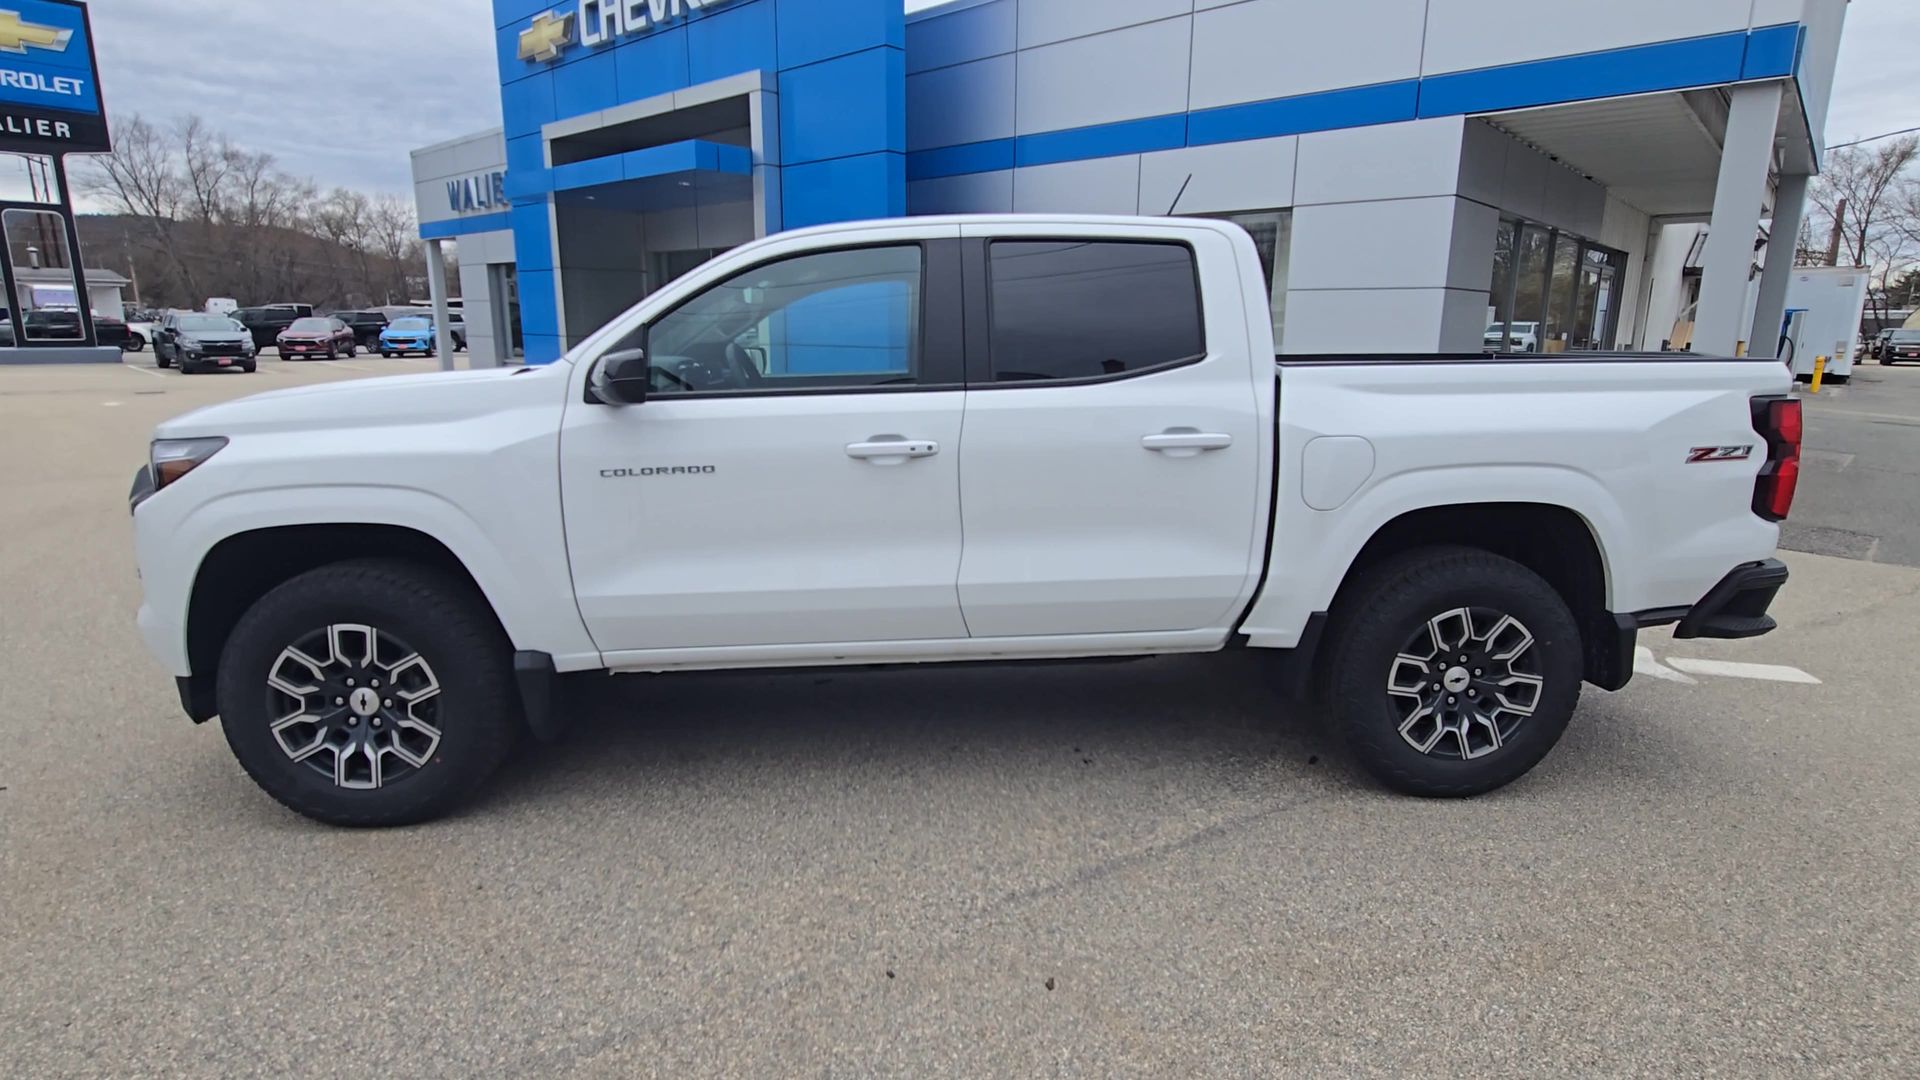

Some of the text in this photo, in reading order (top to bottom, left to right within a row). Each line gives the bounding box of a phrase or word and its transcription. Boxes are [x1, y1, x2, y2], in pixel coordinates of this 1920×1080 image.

[446, 170, 508, 212] WALIE
[1685, 445, 1754, 464] Z71
[600, 465, 715, 478] COLORADO
